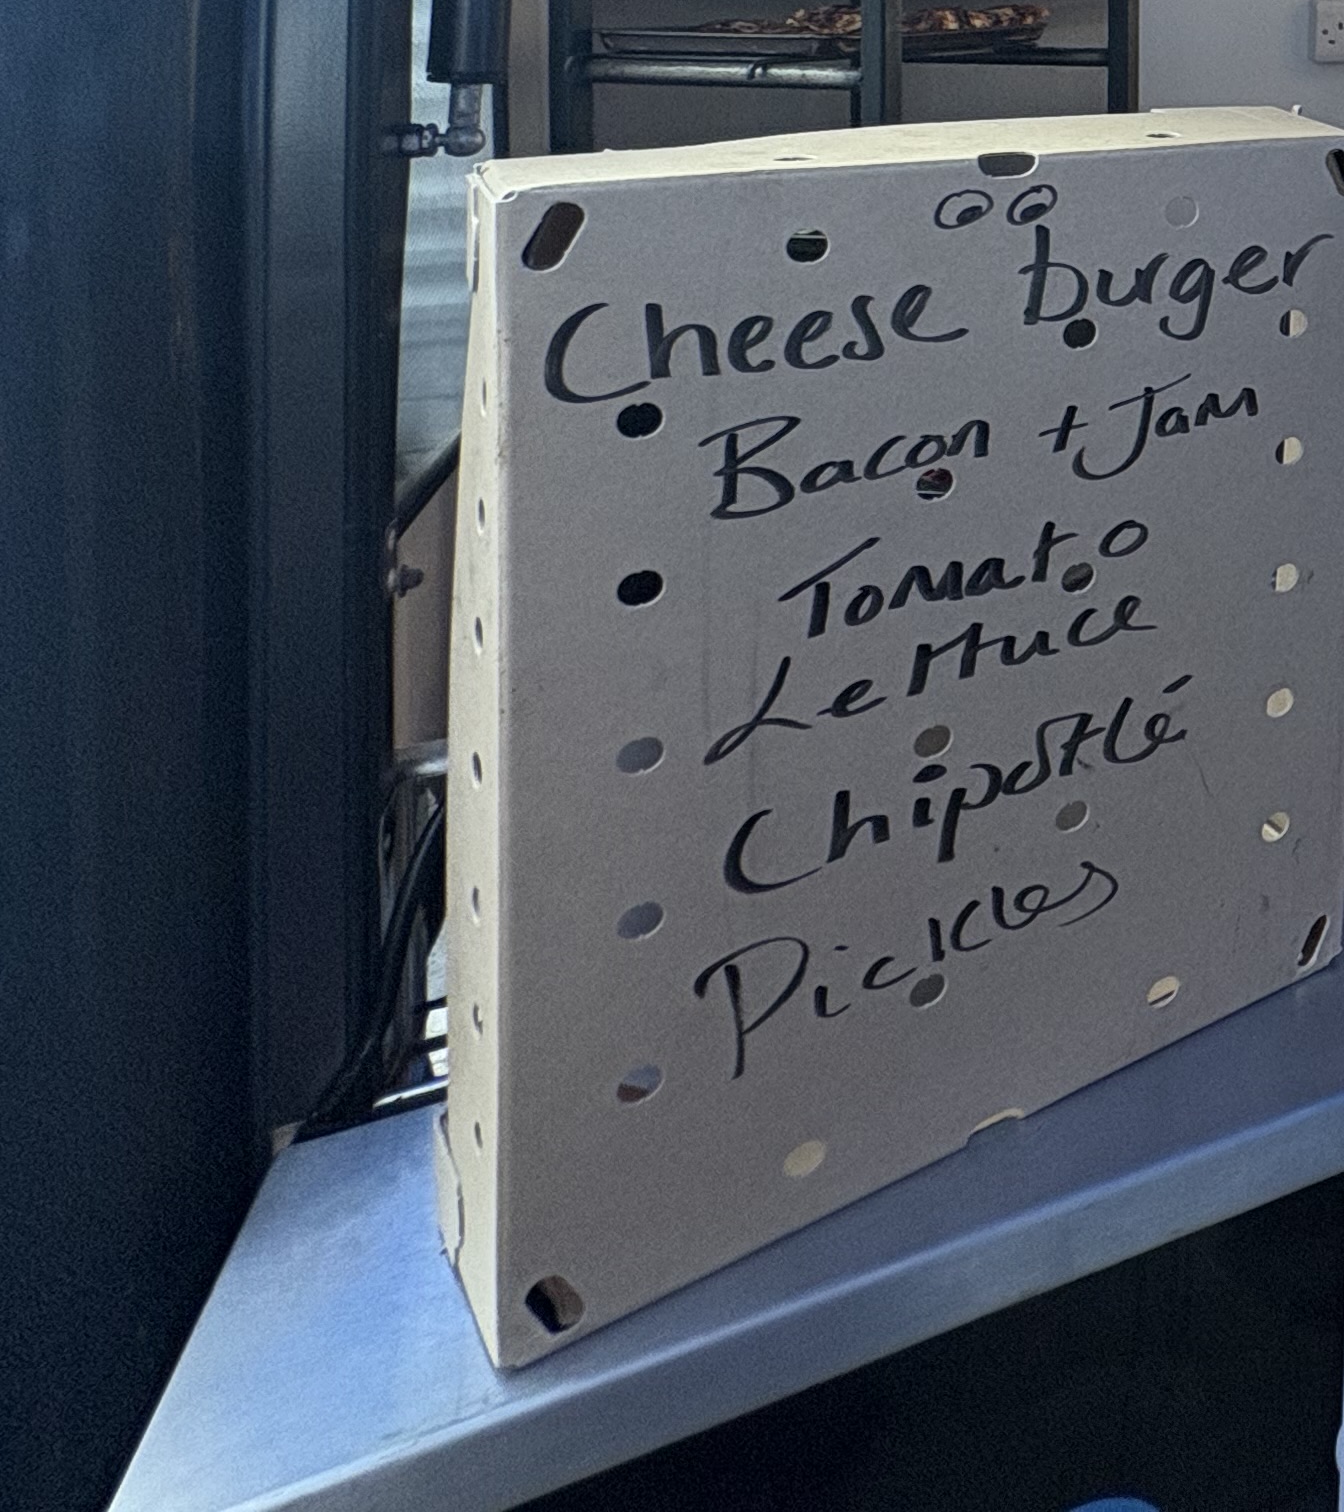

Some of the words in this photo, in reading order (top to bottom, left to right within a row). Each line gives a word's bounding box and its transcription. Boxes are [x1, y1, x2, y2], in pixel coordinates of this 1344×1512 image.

[545, 284, 969, 402] Cheese
[1018, 224, 1334, 341] burger
[699, 416, 990, 519] Bacon
[704, 594, 1158, 765] Lettuce
[693, 861, 1119, 1079] Pickles
